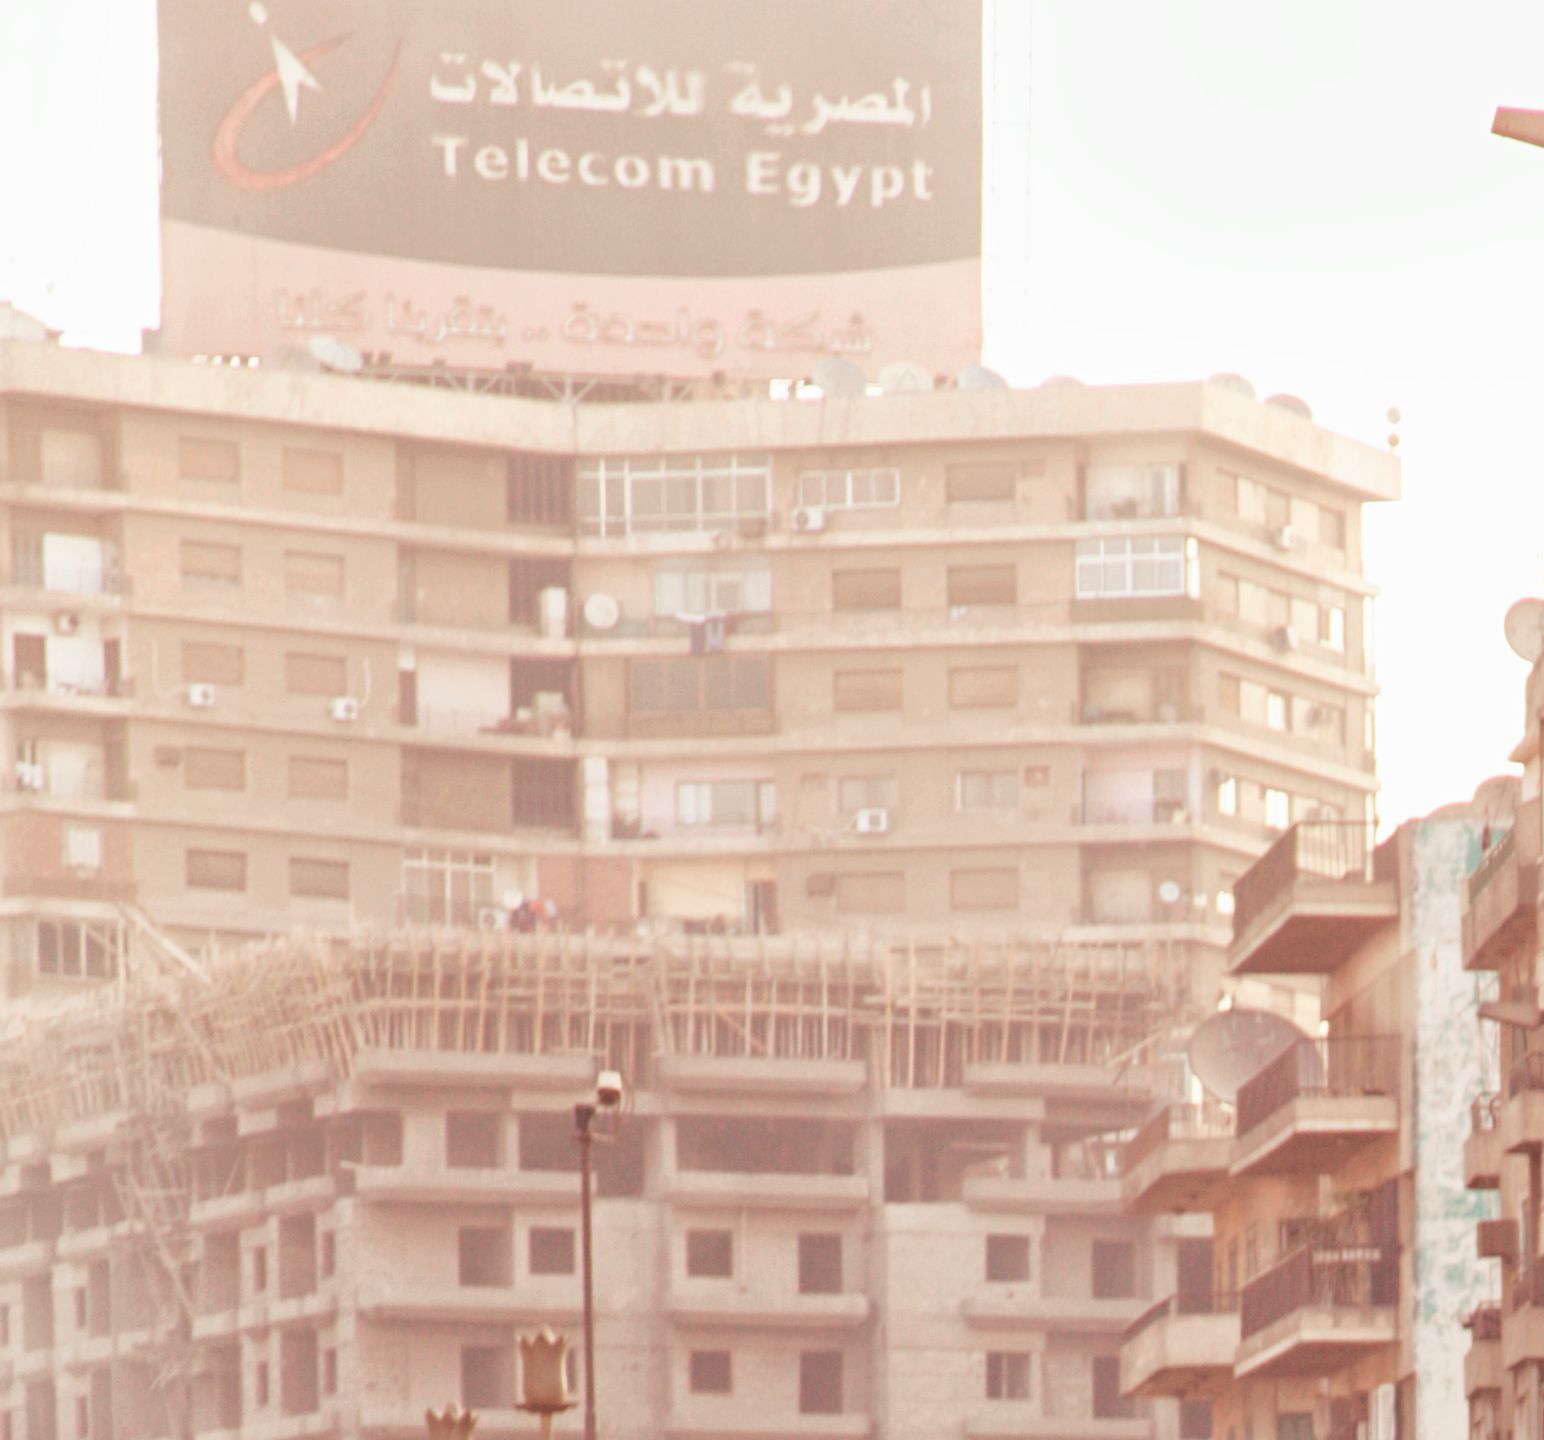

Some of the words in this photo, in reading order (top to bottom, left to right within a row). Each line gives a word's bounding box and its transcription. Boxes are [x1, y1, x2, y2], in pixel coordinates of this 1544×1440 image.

[428, 51, 706, 117] للاتصالات
[727, 61, 933, 136] المصرية
[433, 134, 716, 193] Telecom
[745, 150, 936, 208] Egypt
[275, 287, 370, 332] كلنا
[560, 299, 727, 360] واحدة
[737, 308, 873, 357] شركة
